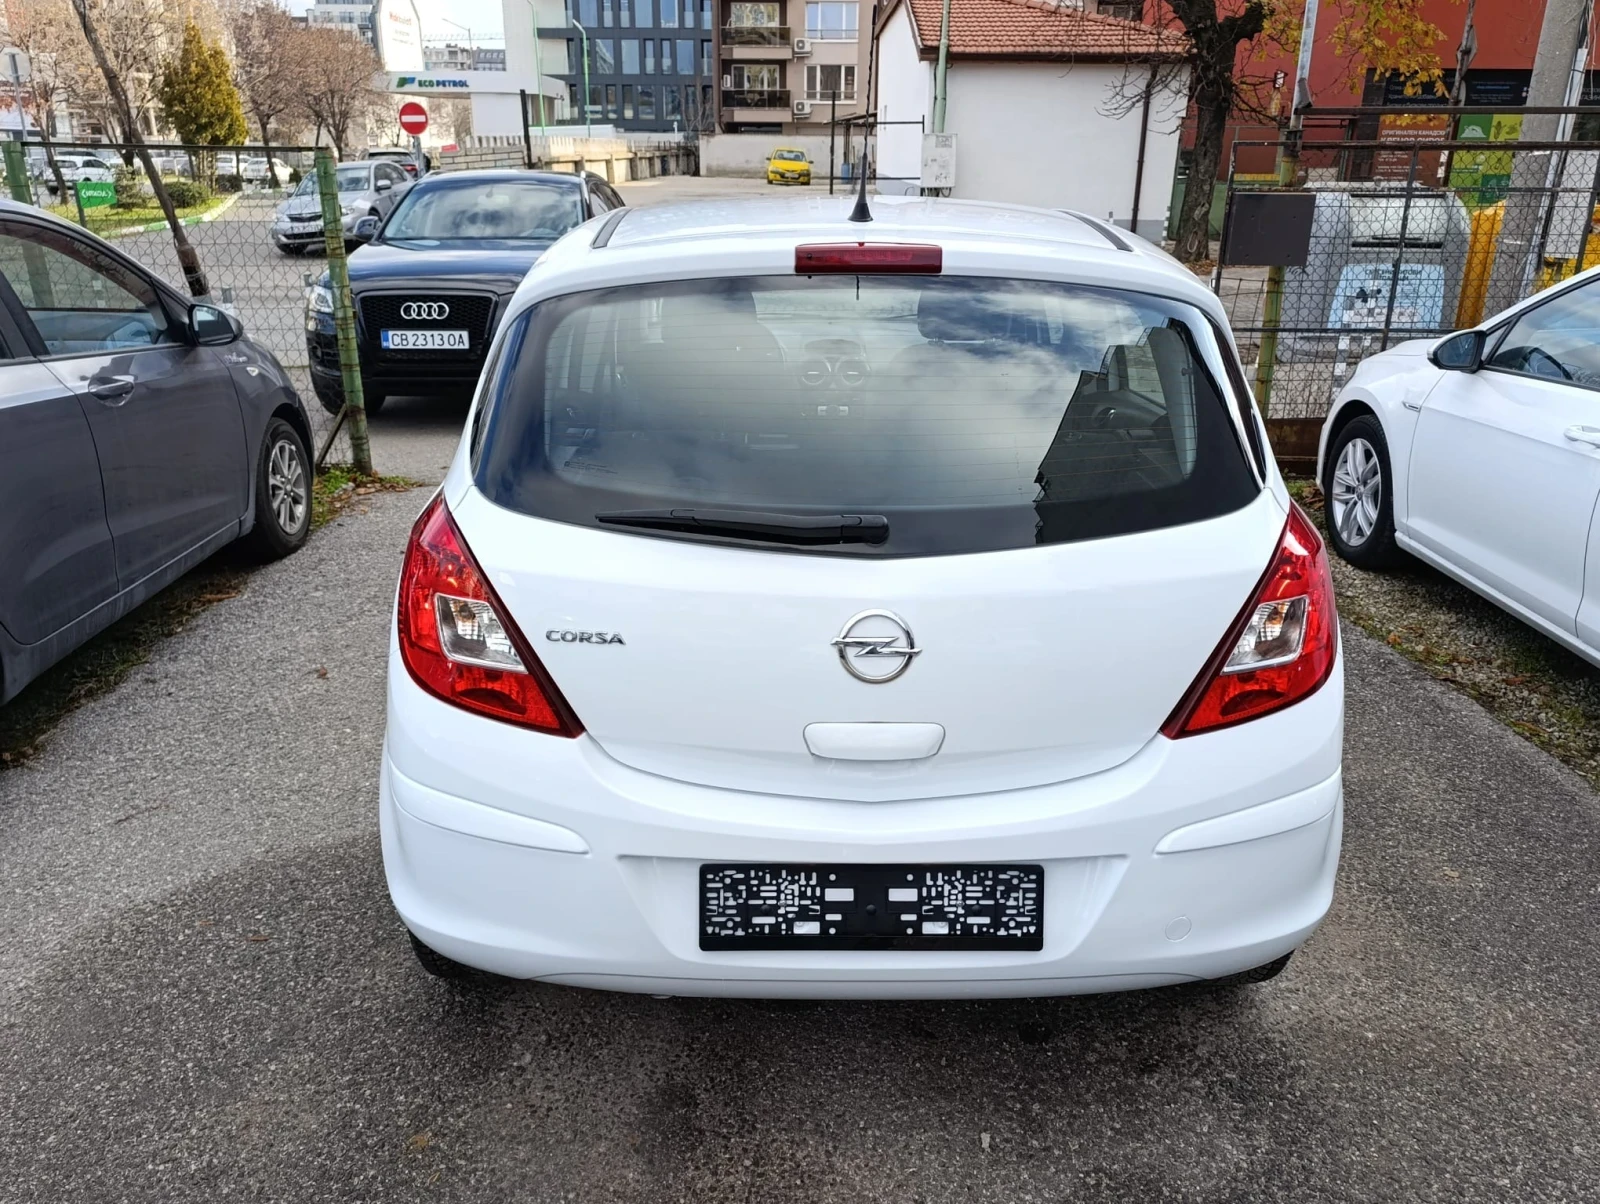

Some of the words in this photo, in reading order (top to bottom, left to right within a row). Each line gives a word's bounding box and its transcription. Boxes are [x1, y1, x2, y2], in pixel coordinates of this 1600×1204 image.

[418, 80, 434, 88] ECO
[436, 80, 469, 88] PETROL
[545, 630, 626, 645] CORSA
